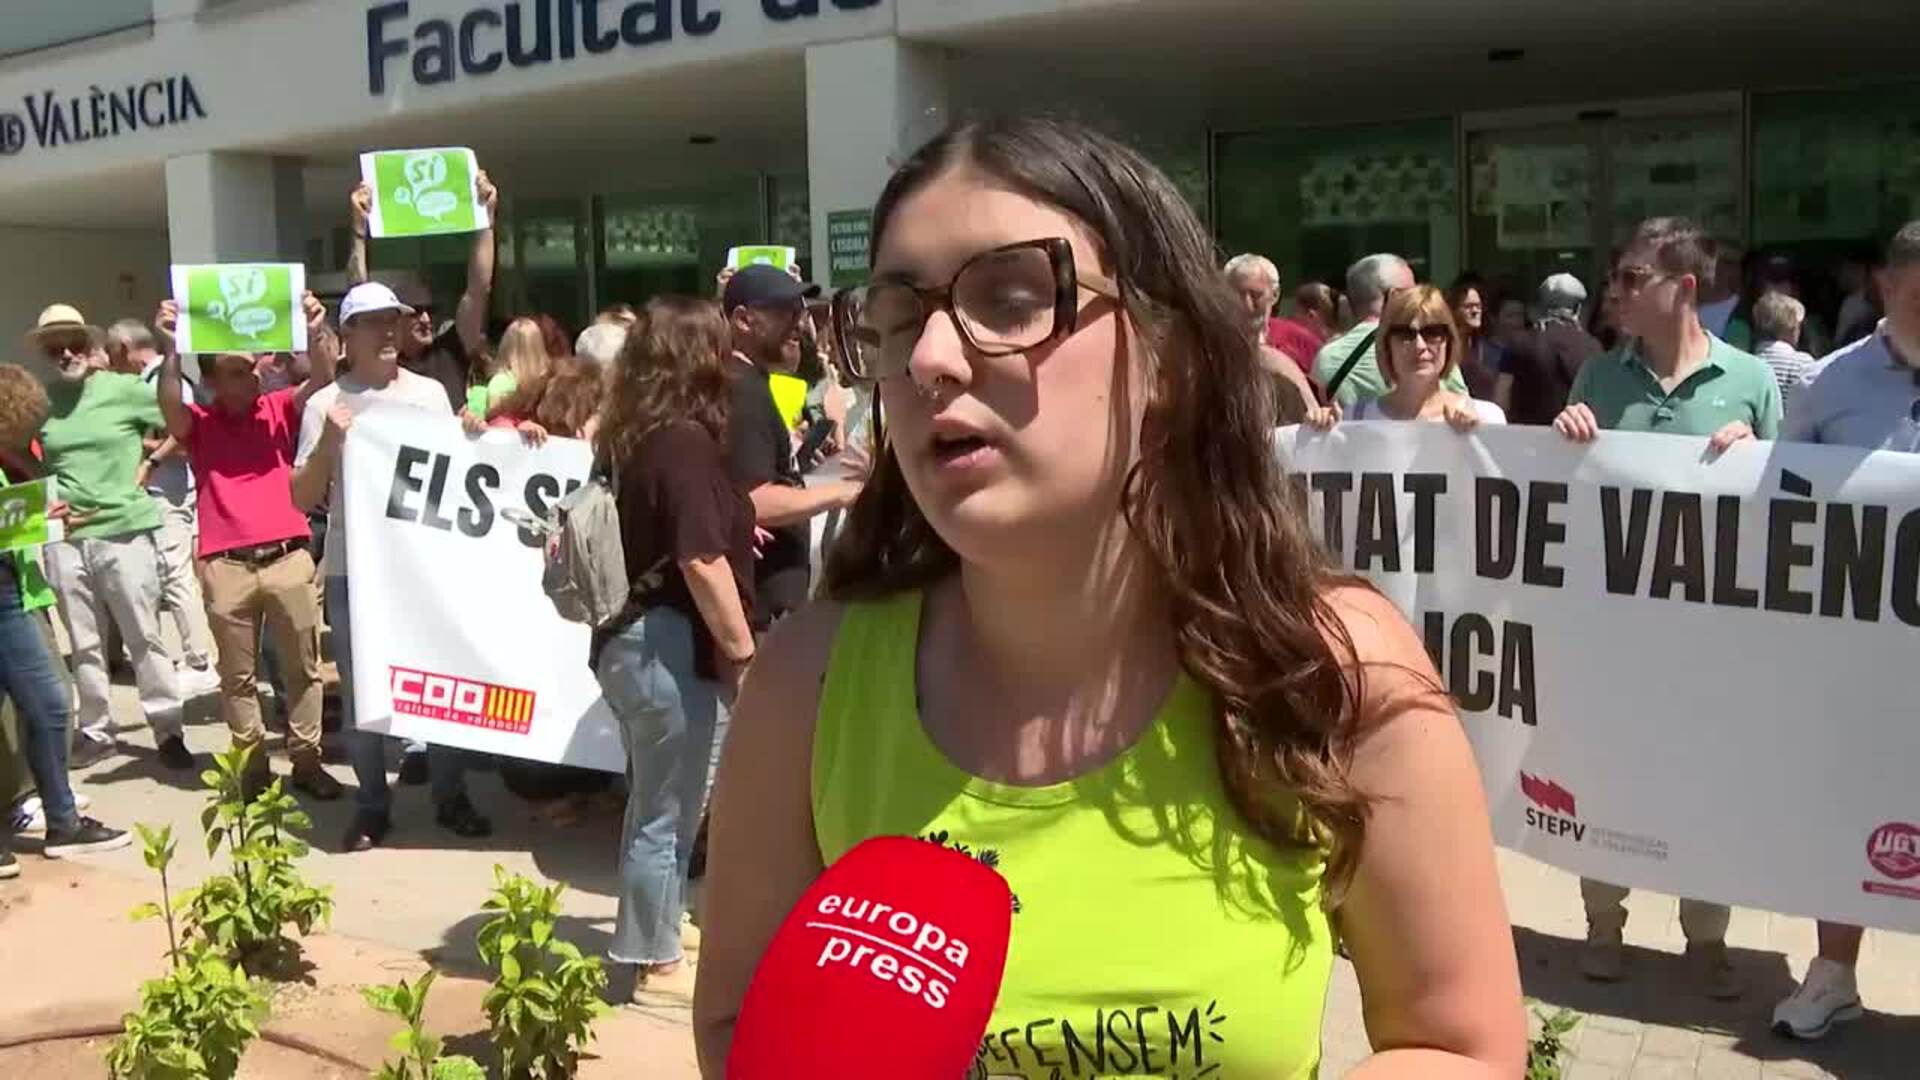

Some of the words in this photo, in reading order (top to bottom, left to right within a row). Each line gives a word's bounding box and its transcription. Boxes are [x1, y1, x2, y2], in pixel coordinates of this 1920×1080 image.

[386, 445, 500, 538] ELS
[1474, 477, 1568, 588] DE
[1526, 807, 1586, 841] STEPV
[817, 894, 969, 968] europa
[816, 936, 950, 1009] press
